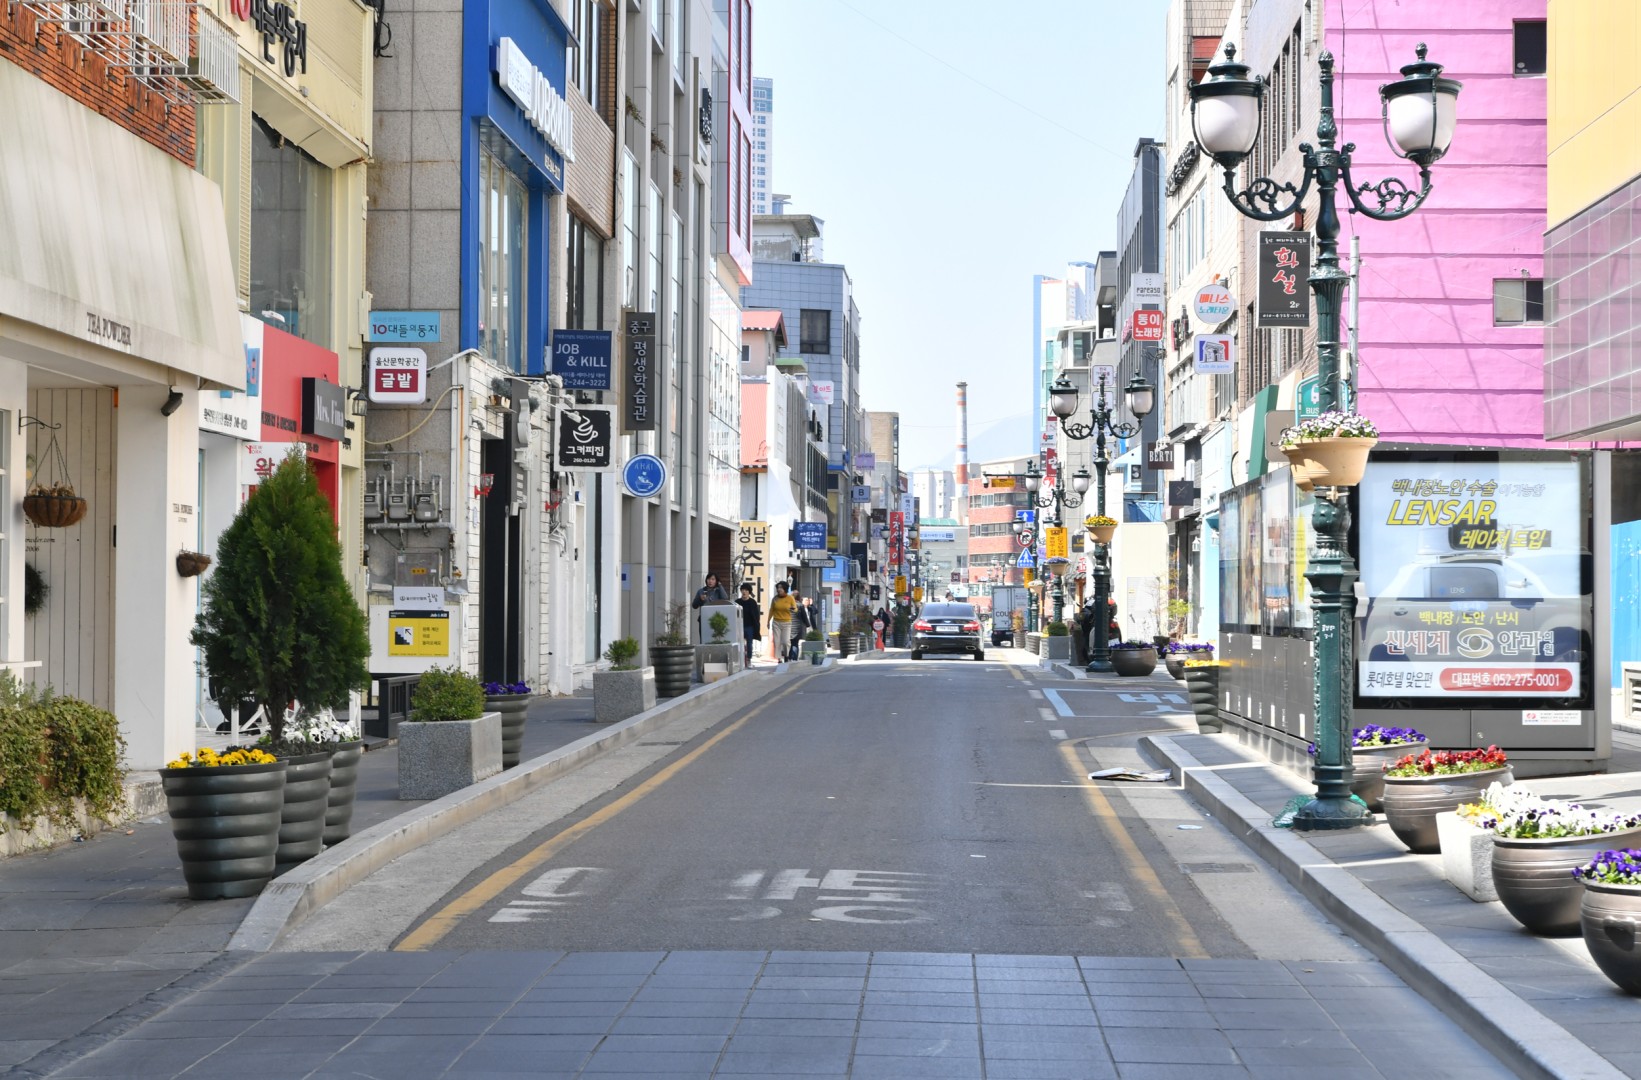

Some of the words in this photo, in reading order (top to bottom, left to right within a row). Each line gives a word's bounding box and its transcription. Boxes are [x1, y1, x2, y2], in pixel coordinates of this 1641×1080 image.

[87, 311, 101, 336] TEA
[102, 317, 132, 346] POWDER
[630, 320, 651, 334] 중구
[1135, 327, 1162, 338] 노래방
[555, 343, 580, 355] JOB
[375, 357, 420, 367] 울산문학공간
[566, 355, 577, 367] &
[580, 356, 608, 368] KILL
[381, 373, 412, 389] 글밭
[563, 378, 607, 387] 2-244-3222
[633, 341, 648, 422] 평생학습관
[1305, 407, 1320, 415] BUS
[565, 445, 605, 457] 그커피집
[1149, 450, 1173, 462] BERTI
[1391, 479, 1466, 497] 백내장노안
[1466, 479, 1498, 497] 수술
[1386, 499, 1496, 526] LENSAR
[738, 526, 767, 544] 성남
[1459, 529, 1511, 550] 레이저
[1510, 529, 1547, 550] 도입
[1418, 611, 1454, 625] 백내장
[1461, 611, 1486, 625] 노안
[1495, 611, 1519, 625] 난시
[1383, 630, 1451, 656] 신세계
[1366, 671, 1404, 689] 롯데호텔
[1405, 671, 1434, 689] 맞은편
[1451, 672, 1491, 687] 대표번호
[1492, 673, 1560, 687] 052-275-0001
